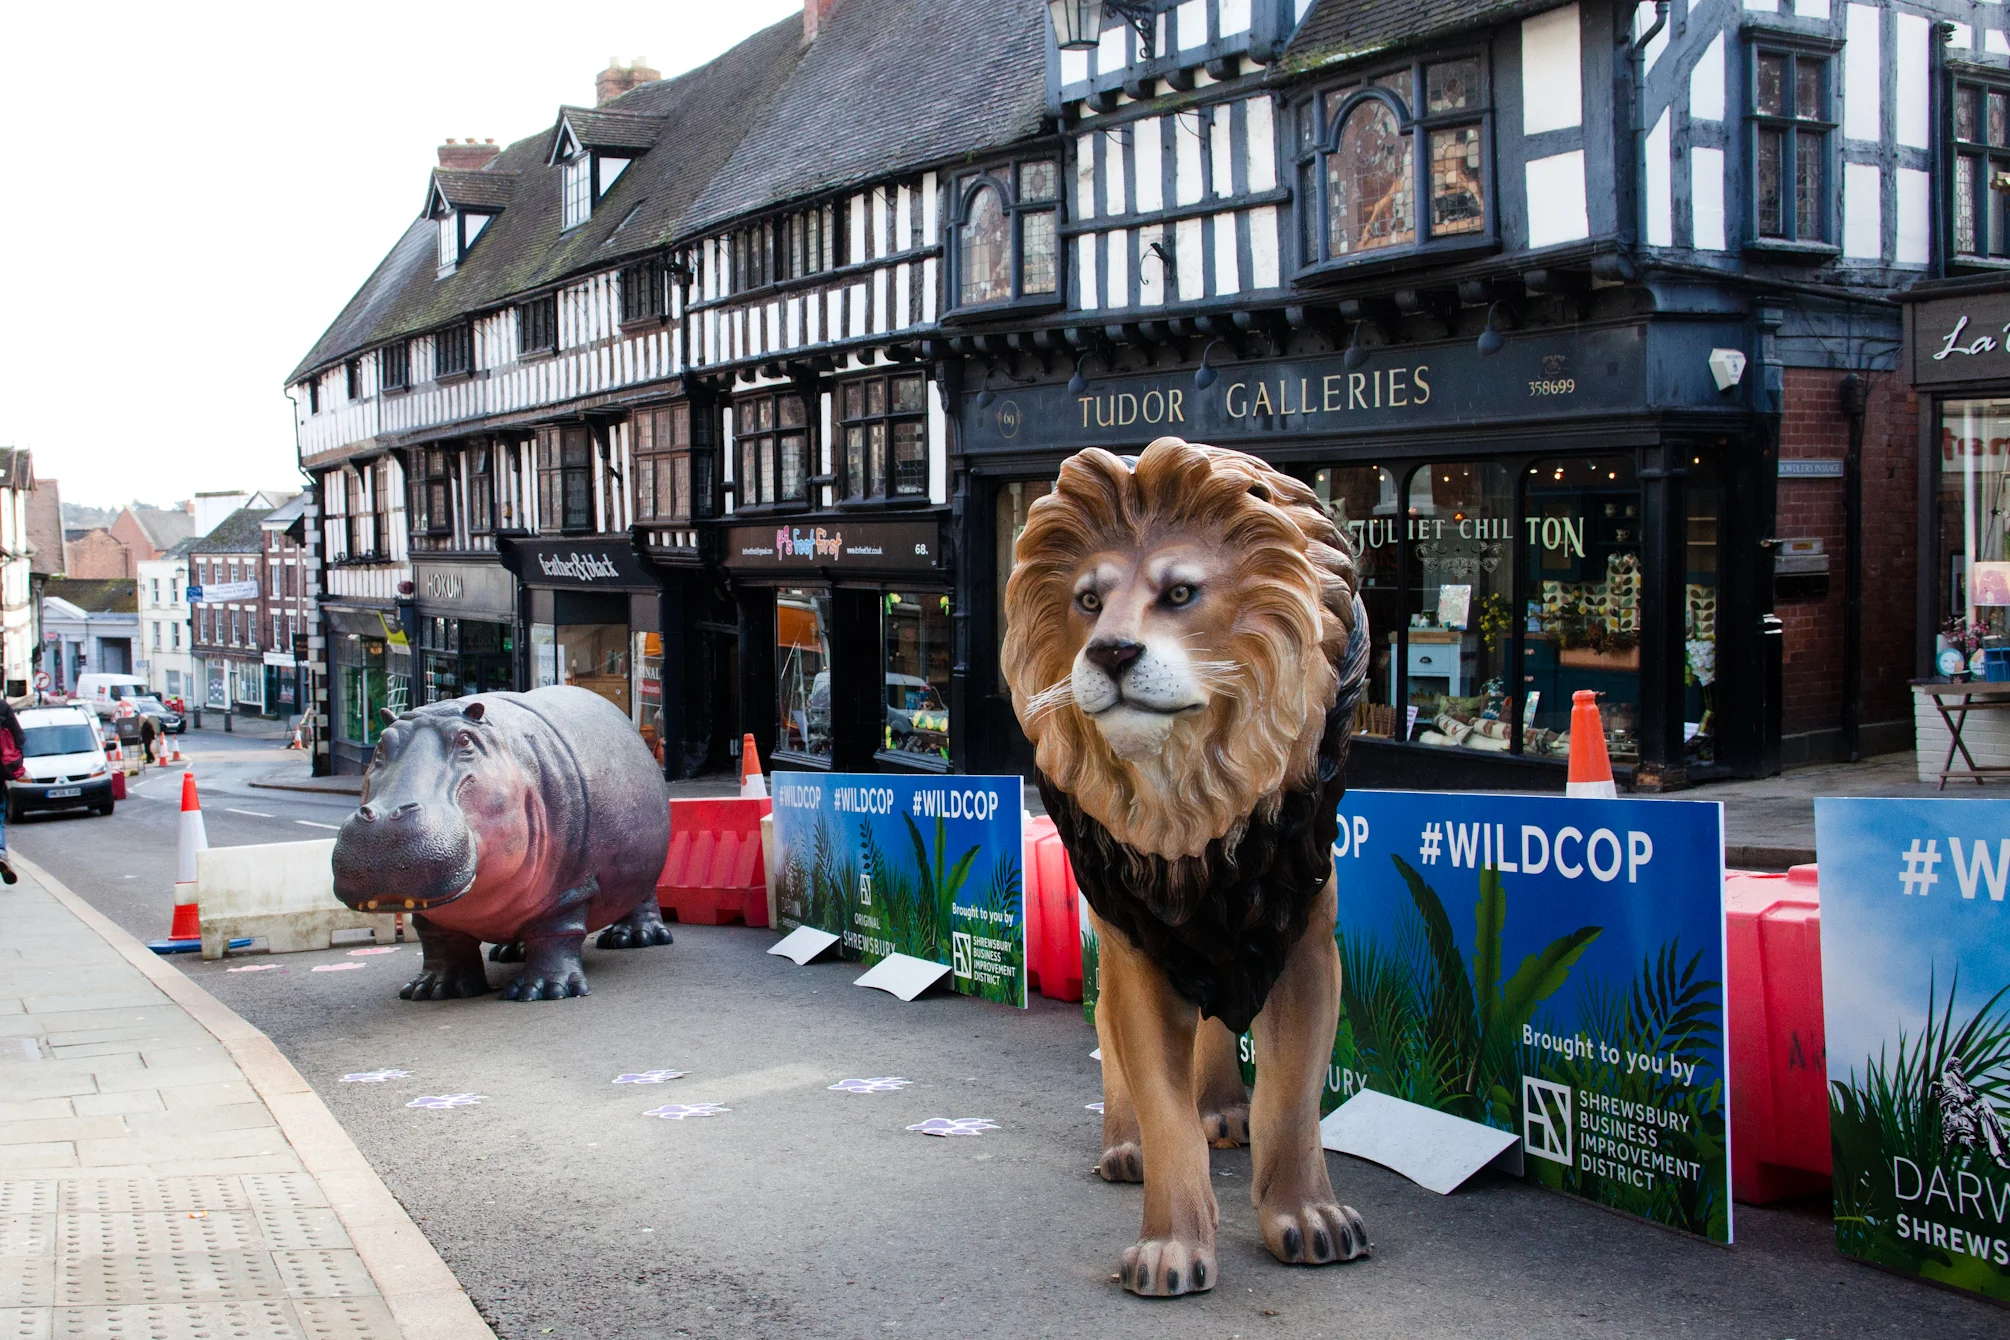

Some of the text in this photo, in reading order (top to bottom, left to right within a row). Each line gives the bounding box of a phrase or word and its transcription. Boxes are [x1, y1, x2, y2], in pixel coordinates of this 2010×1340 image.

[1932, 315, 1997, 360] La
[1078, 365, 1430, 428] TUDOR GALLERIES
[1528, 379, 1575, 396] 358699
[1003, 411, 1015, 427] 69
[1814, 463, 1840, 473] PASSAGE
[1347, 518, 1446, 559] JULIET
[538, 552, 619, 581] feather&black
[426, 573, 464, 599] HOKUM
[638, 666, 661, 680] FINAL
[779, 785, 821, 810] #WILDCOP
[834, 787, 894, 815] #WILDCOP
[913, 790, 999, 821] #WILDCOP
[1419, 821, 1653, 883] #WILDCOP
[1899, 837, 2010, 901] #W
[854, 913, 880, 930] ORIGINAL
[952, 902, 1013, 927] Brought to you by
[843, 930, 896, 957] SHREWSBURY
[973, 935, 1012, 952] SHREWSBURY
[973, 947, 1001, 962] BUSINESS
[973, 960, 1016, 977] IMPROVEMENT
[974, 971, 1000, 986] DISTRICT
[1522, 1023, 1695, 1087] Brought to you by
[1579, 1090, 1689, 1133] SHREWSBURY
[1580, 1111, 1658, 1147] BUSINESS
[1581, 1132, 1700, 1181] IMPROVEMENT
[1581, 1154, 1655, 1191] DISTRICT
[1896, 1213, 2009, 1266] SHREWS
